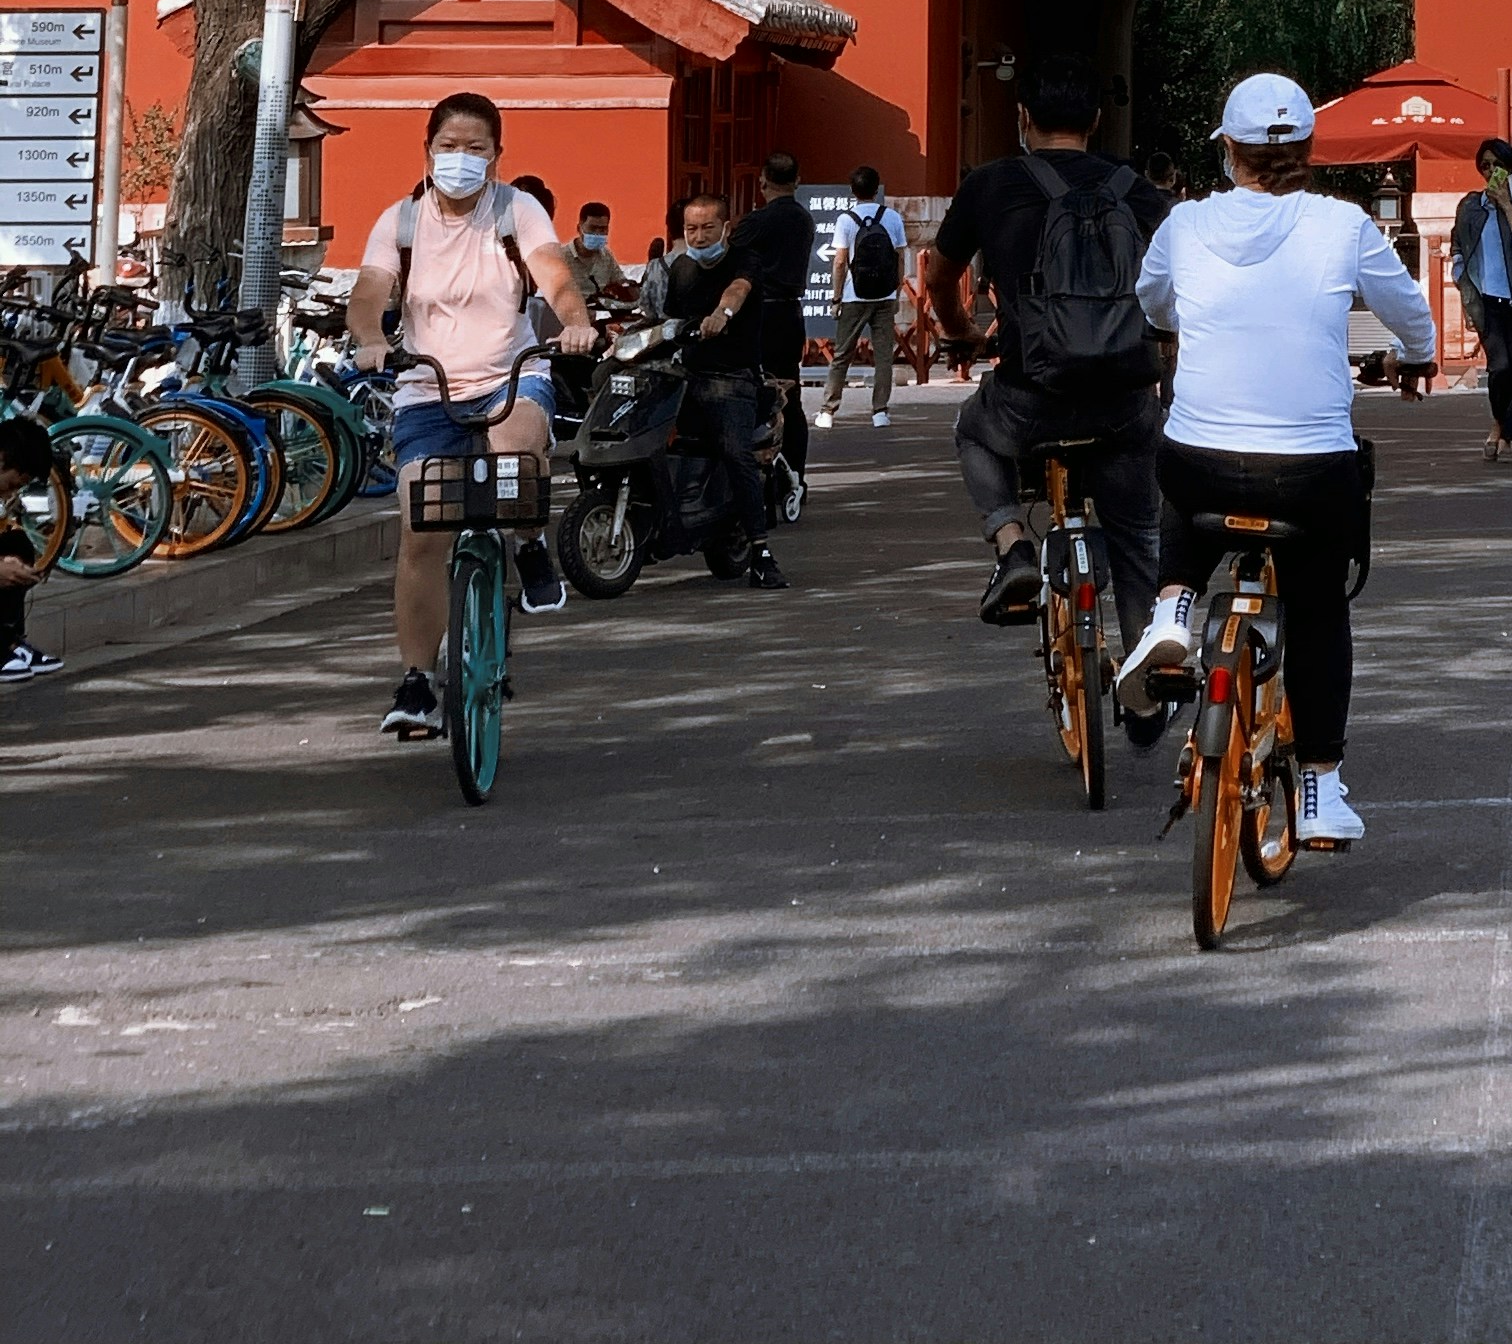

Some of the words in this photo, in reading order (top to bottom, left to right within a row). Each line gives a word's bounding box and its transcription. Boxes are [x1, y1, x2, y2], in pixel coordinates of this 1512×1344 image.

[31, 21, 65, 33] 590m
[28, 37, 61, 46] Museum
[29, 64, 62, 74] 510m
[26, 106, 60, 117] 920m
[18, 149, 58, 161] 1300m
[17, 191, 57, 202] 1350m
[14, 235, 55, 246] 2550m
